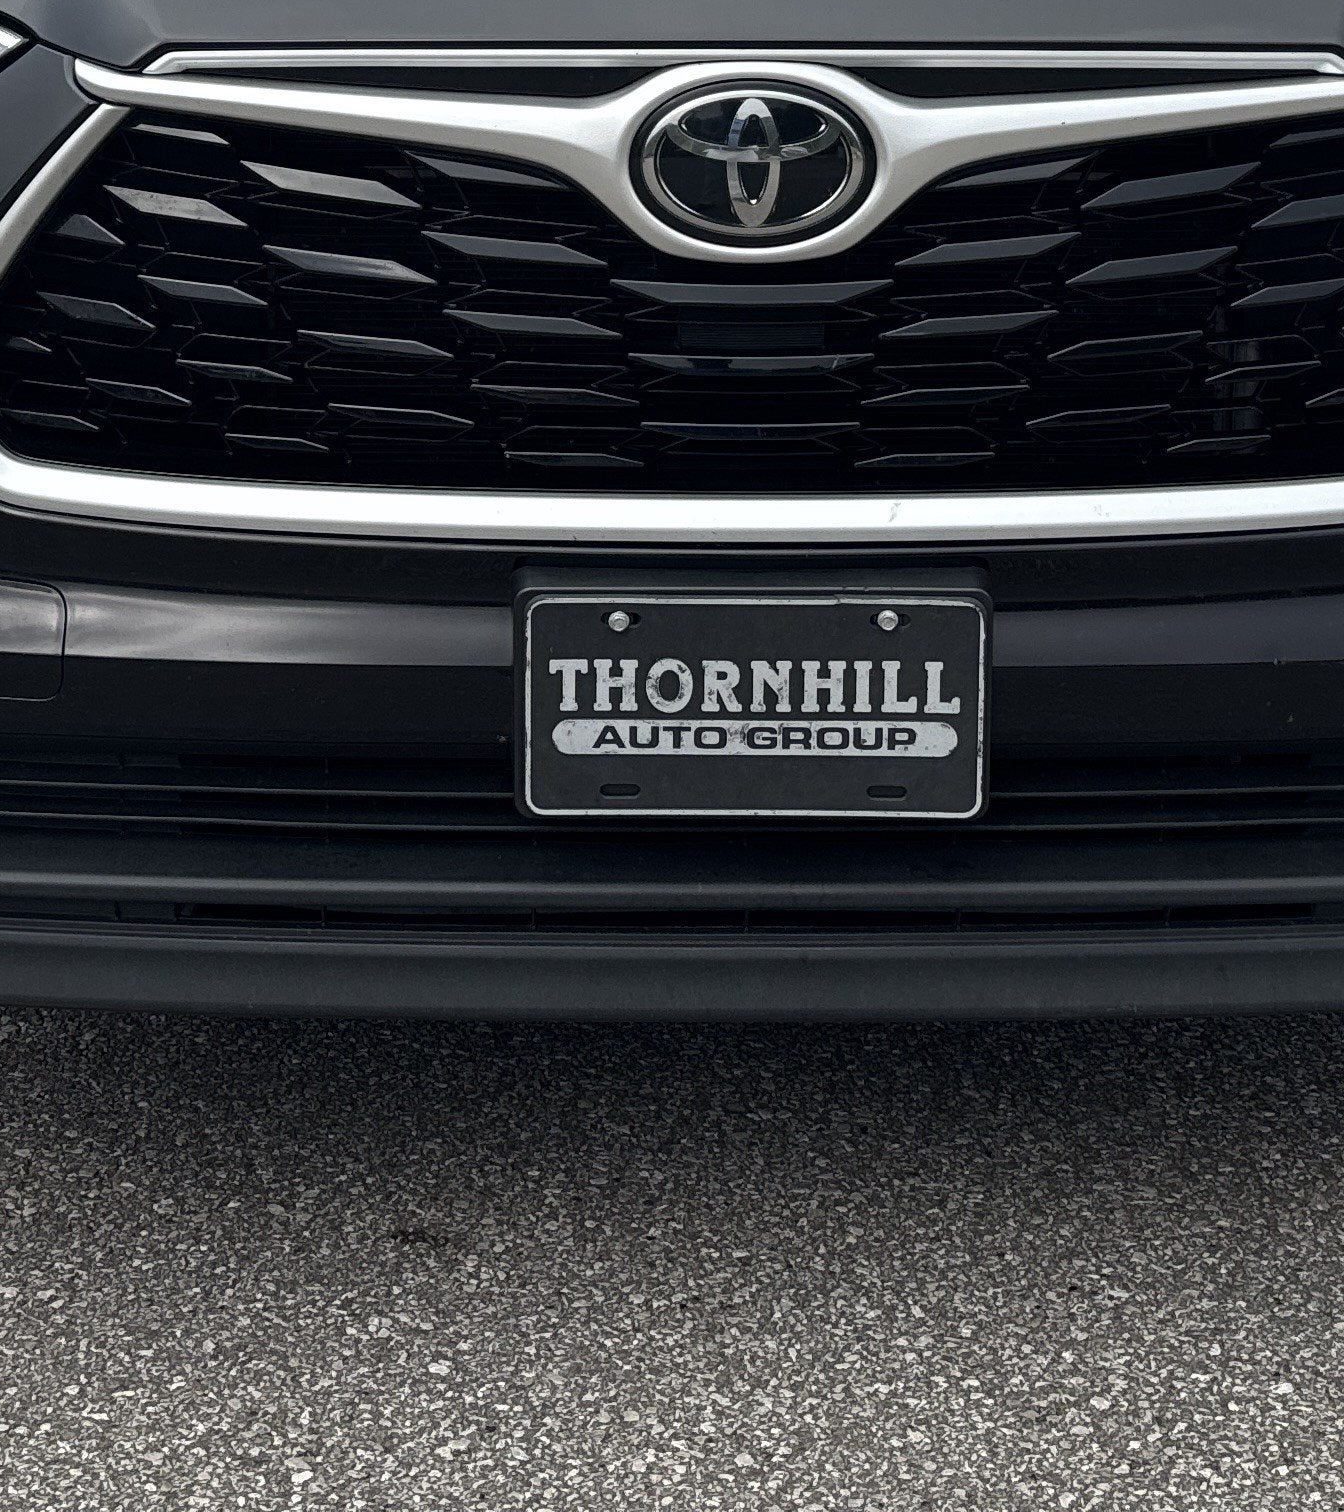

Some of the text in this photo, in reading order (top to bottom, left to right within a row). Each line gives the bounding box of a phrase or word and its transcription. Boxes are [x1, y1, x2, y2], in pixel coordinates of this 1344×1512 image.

[548, 658, 961, 714] THORNHILL
[592, 724, 917, 751] AUTO GROUP
